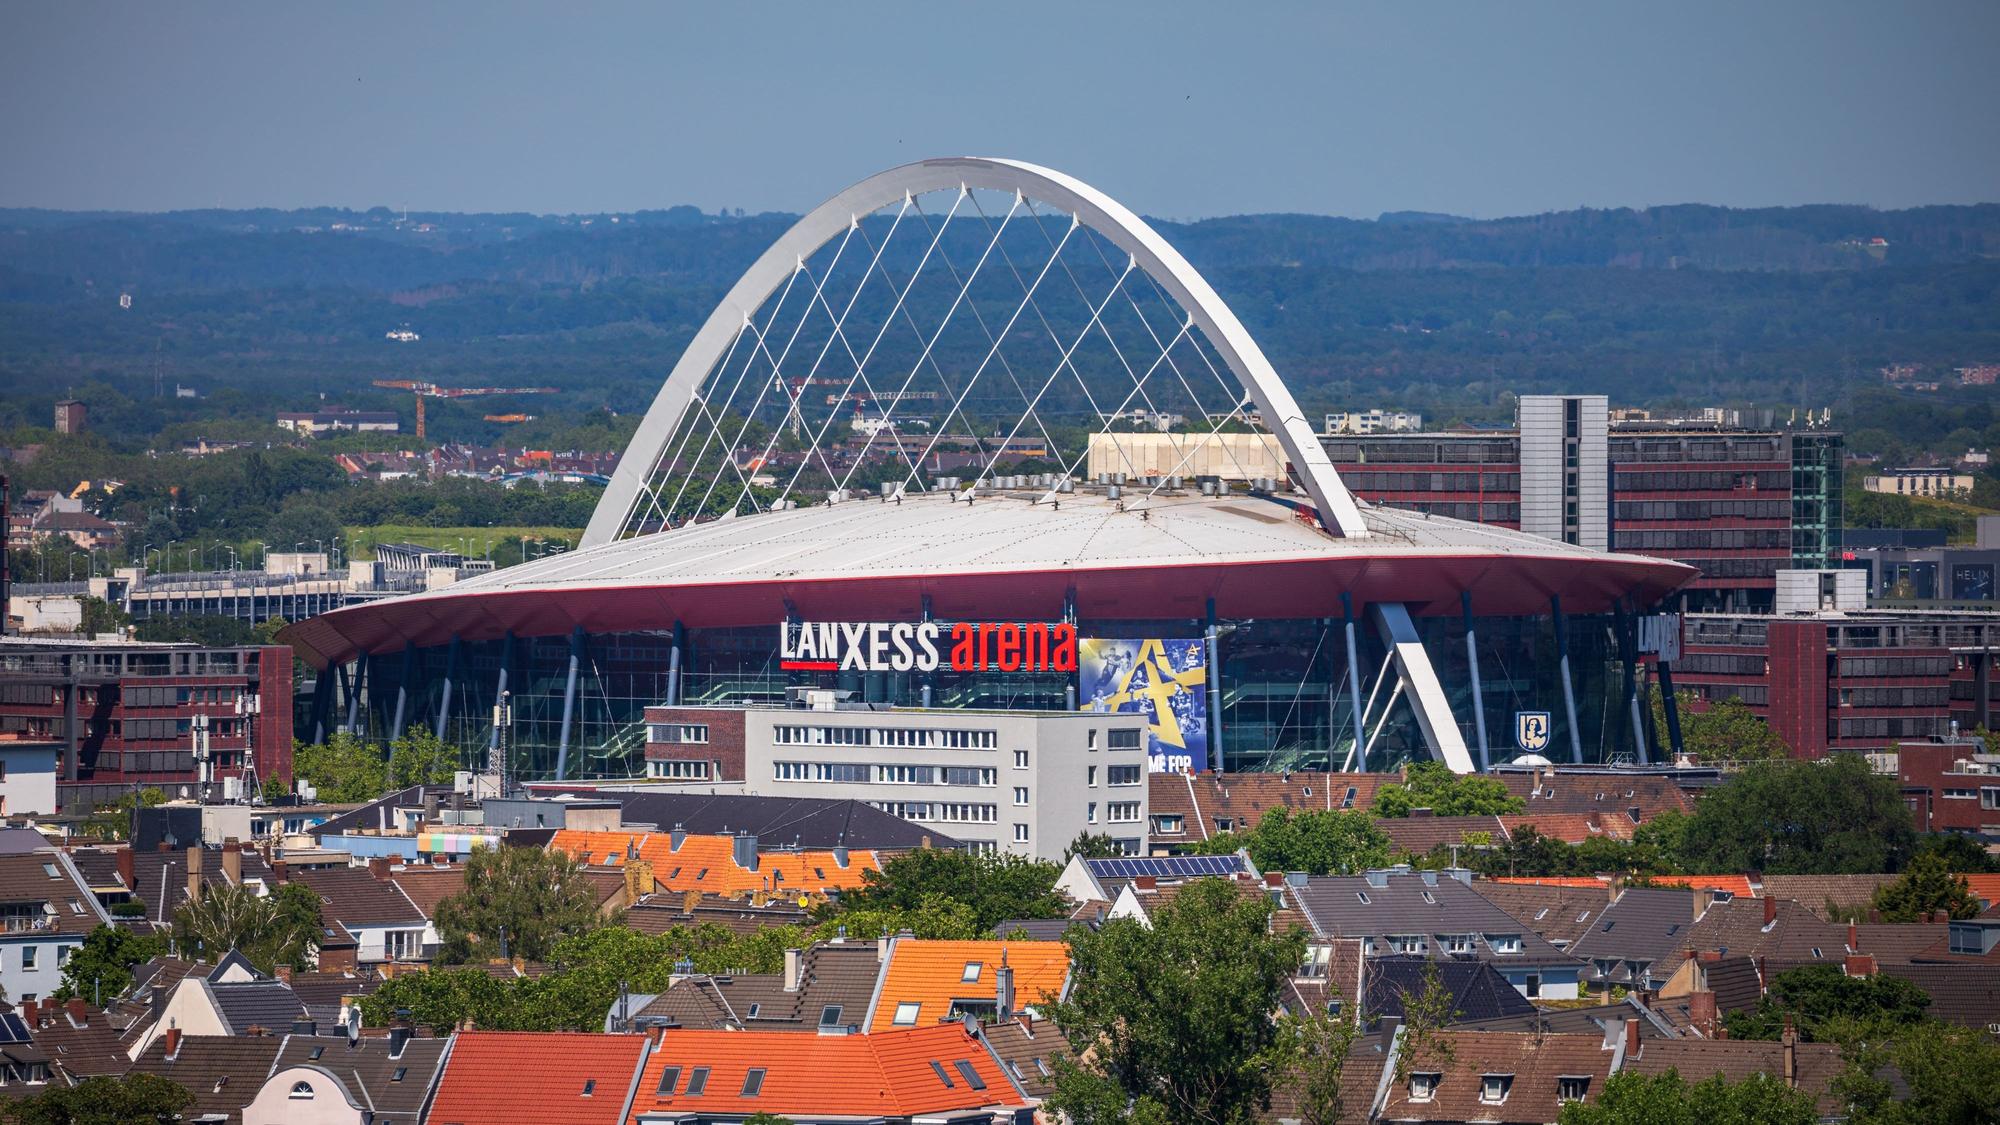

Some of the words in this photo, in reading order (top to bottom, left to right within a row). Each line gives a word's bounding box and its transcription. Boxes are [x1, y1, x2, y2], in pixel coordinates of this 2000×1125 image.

[1956, 569, 1990, 580] HELIX
[780, 621, 938, 671] LANXESS
[951, 621, 1076, 671] arena
